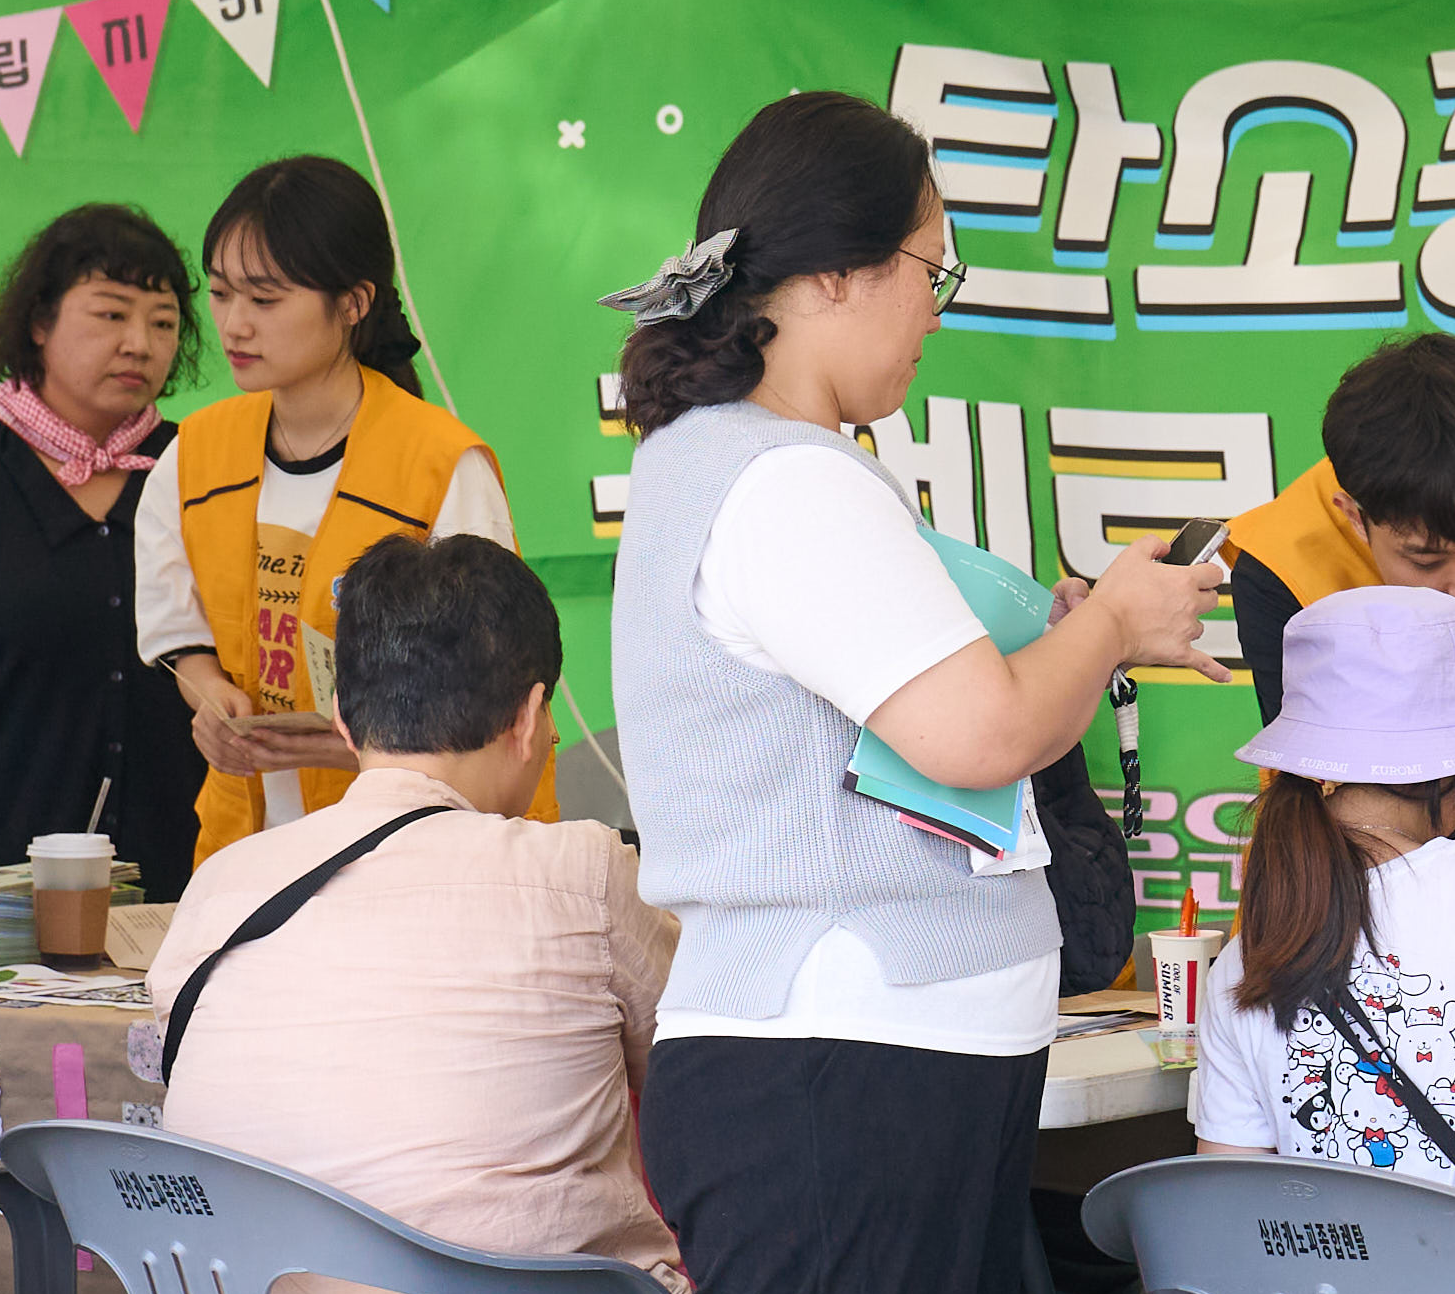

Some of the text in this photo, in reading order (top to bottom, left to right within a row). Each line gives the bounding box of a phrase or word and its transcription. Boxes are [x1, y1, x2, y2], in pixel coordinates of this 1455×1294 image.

[1298, 756, 1349, 774] KUROMI
[1370, 763, 1423, 776] KUROMI
[1160, 961, 1174, 1021] SUMMER
[1257, 1218, 1370, 1261] 삼성캐노피종합렌탈
